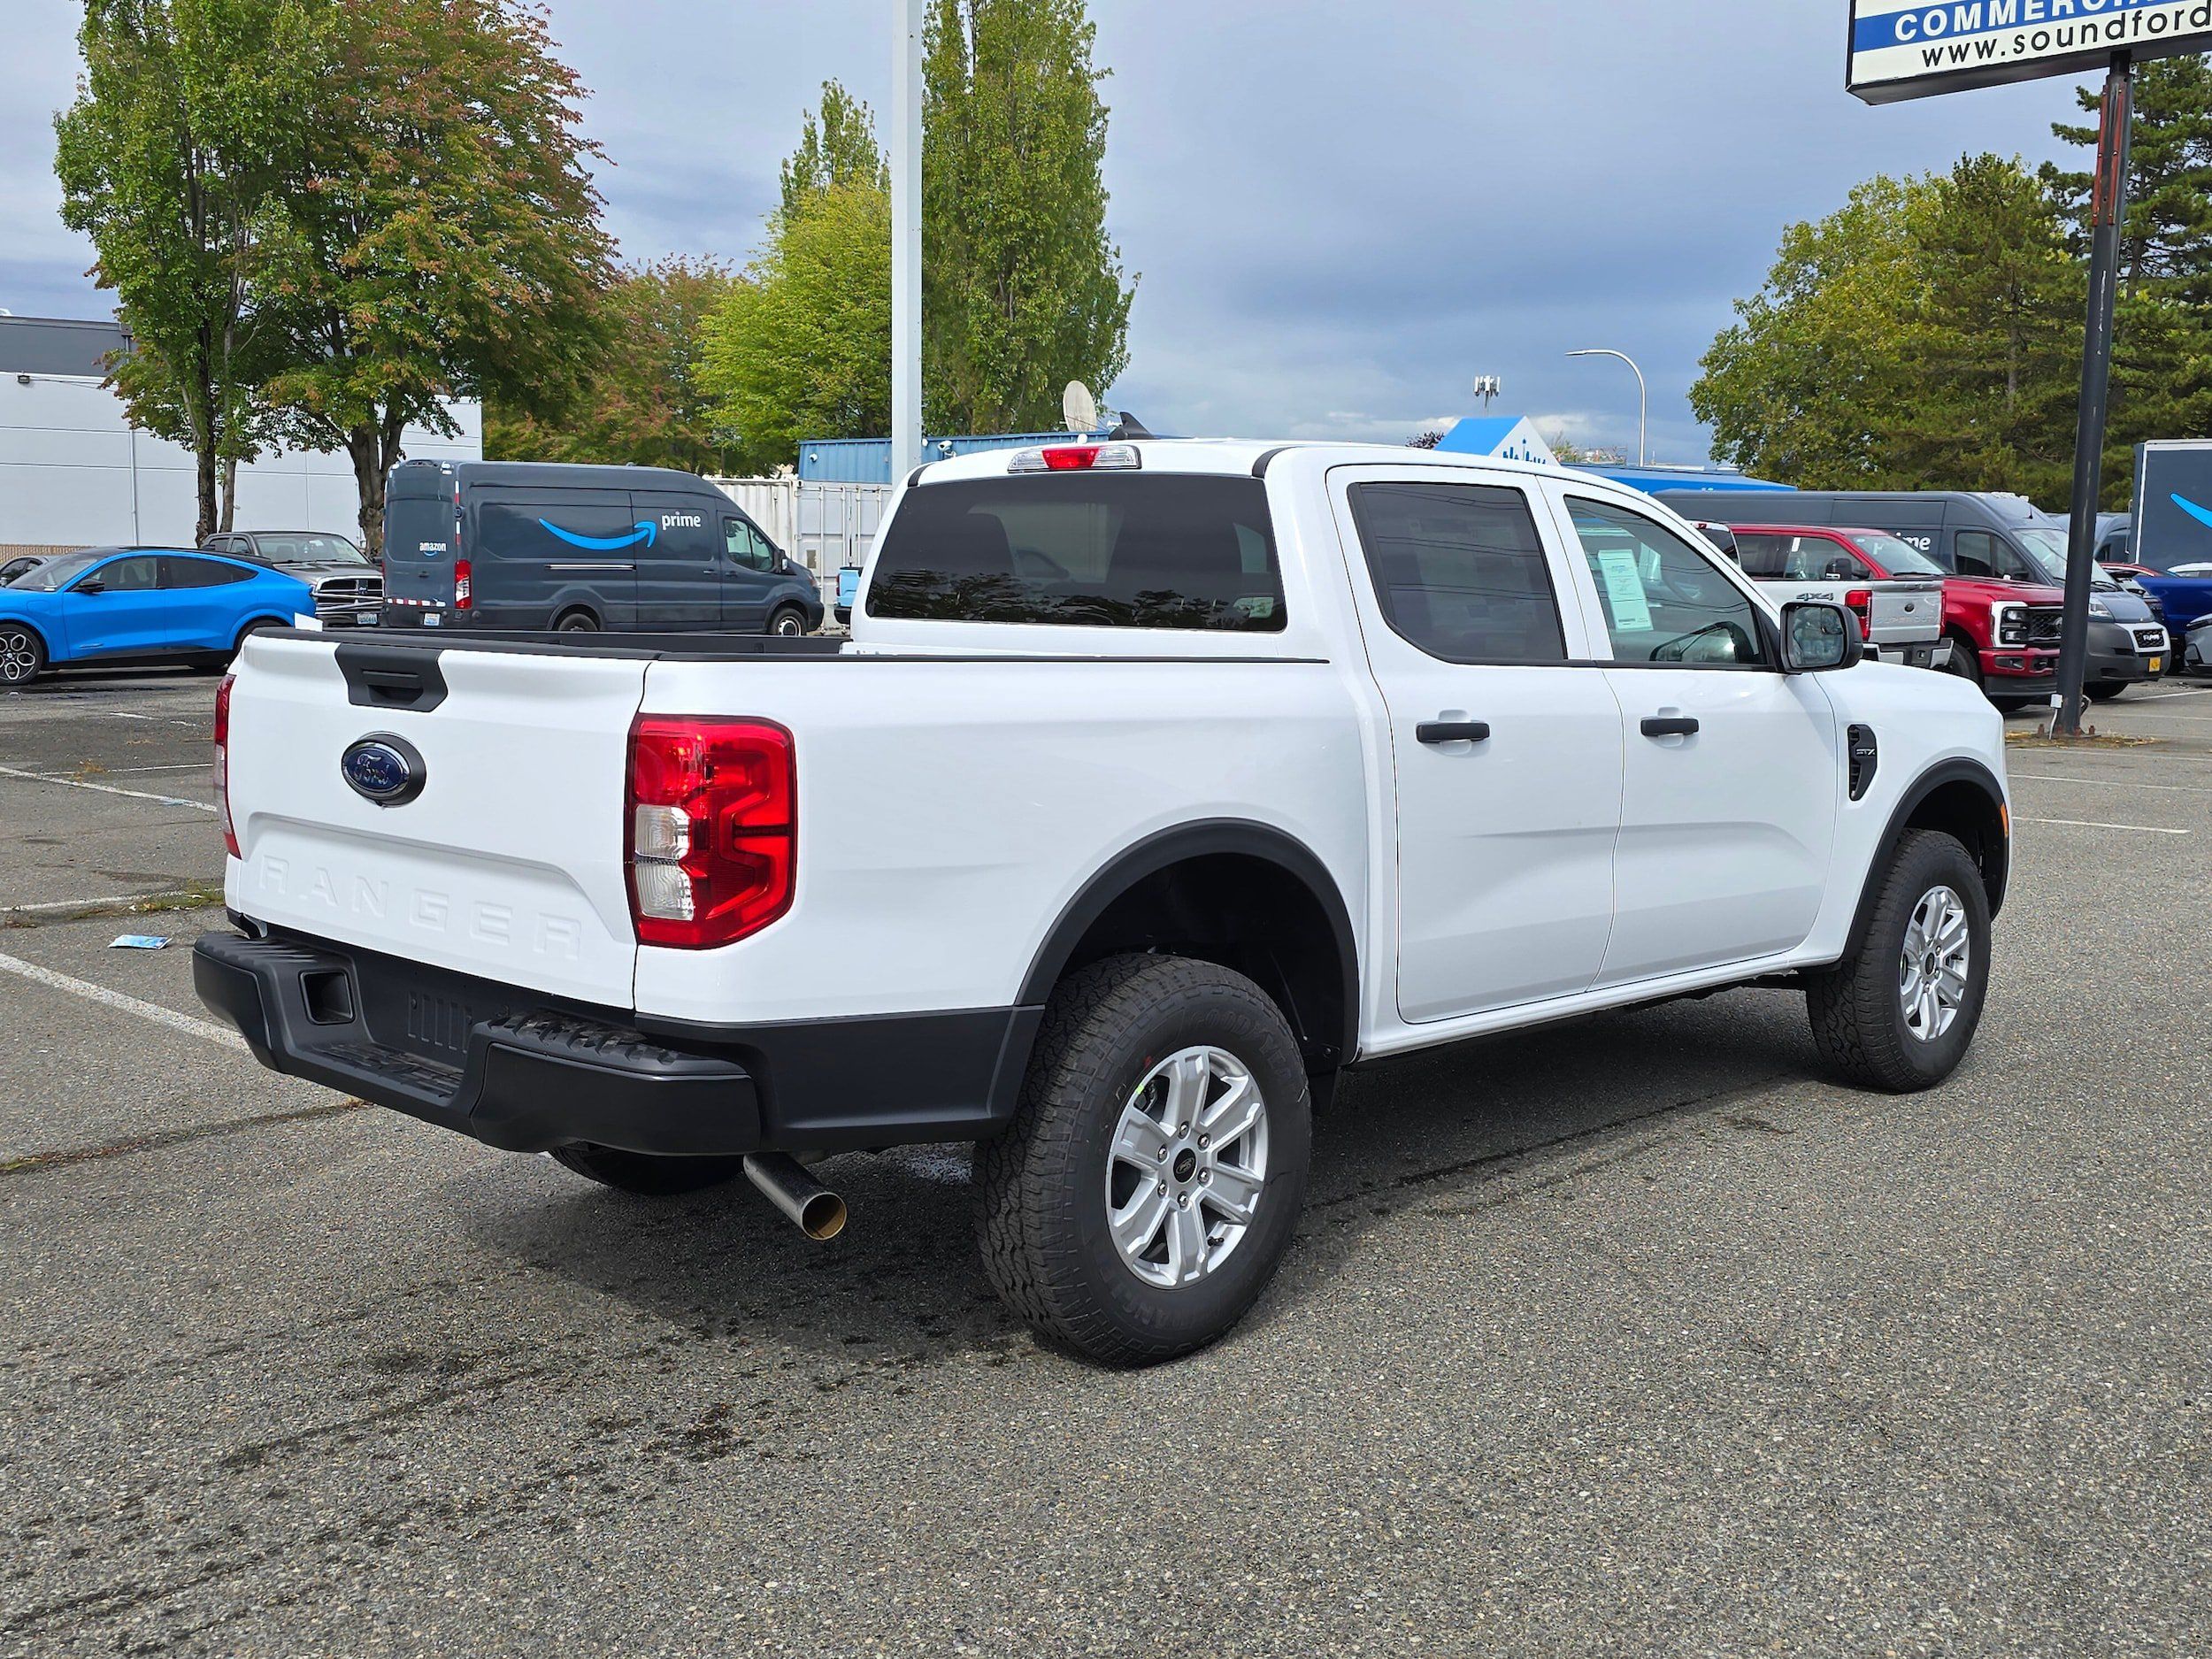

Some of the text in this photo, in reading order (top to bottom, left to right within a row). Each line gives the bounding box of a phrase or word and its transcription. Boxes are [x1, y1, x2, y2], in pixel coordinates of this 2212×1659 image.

[661, 511, 702, 531] prime
[419, 541, 447, 552] amazon
[354, 752, 390, 786] Ford
[258, 855, 582, 962] RANGER
